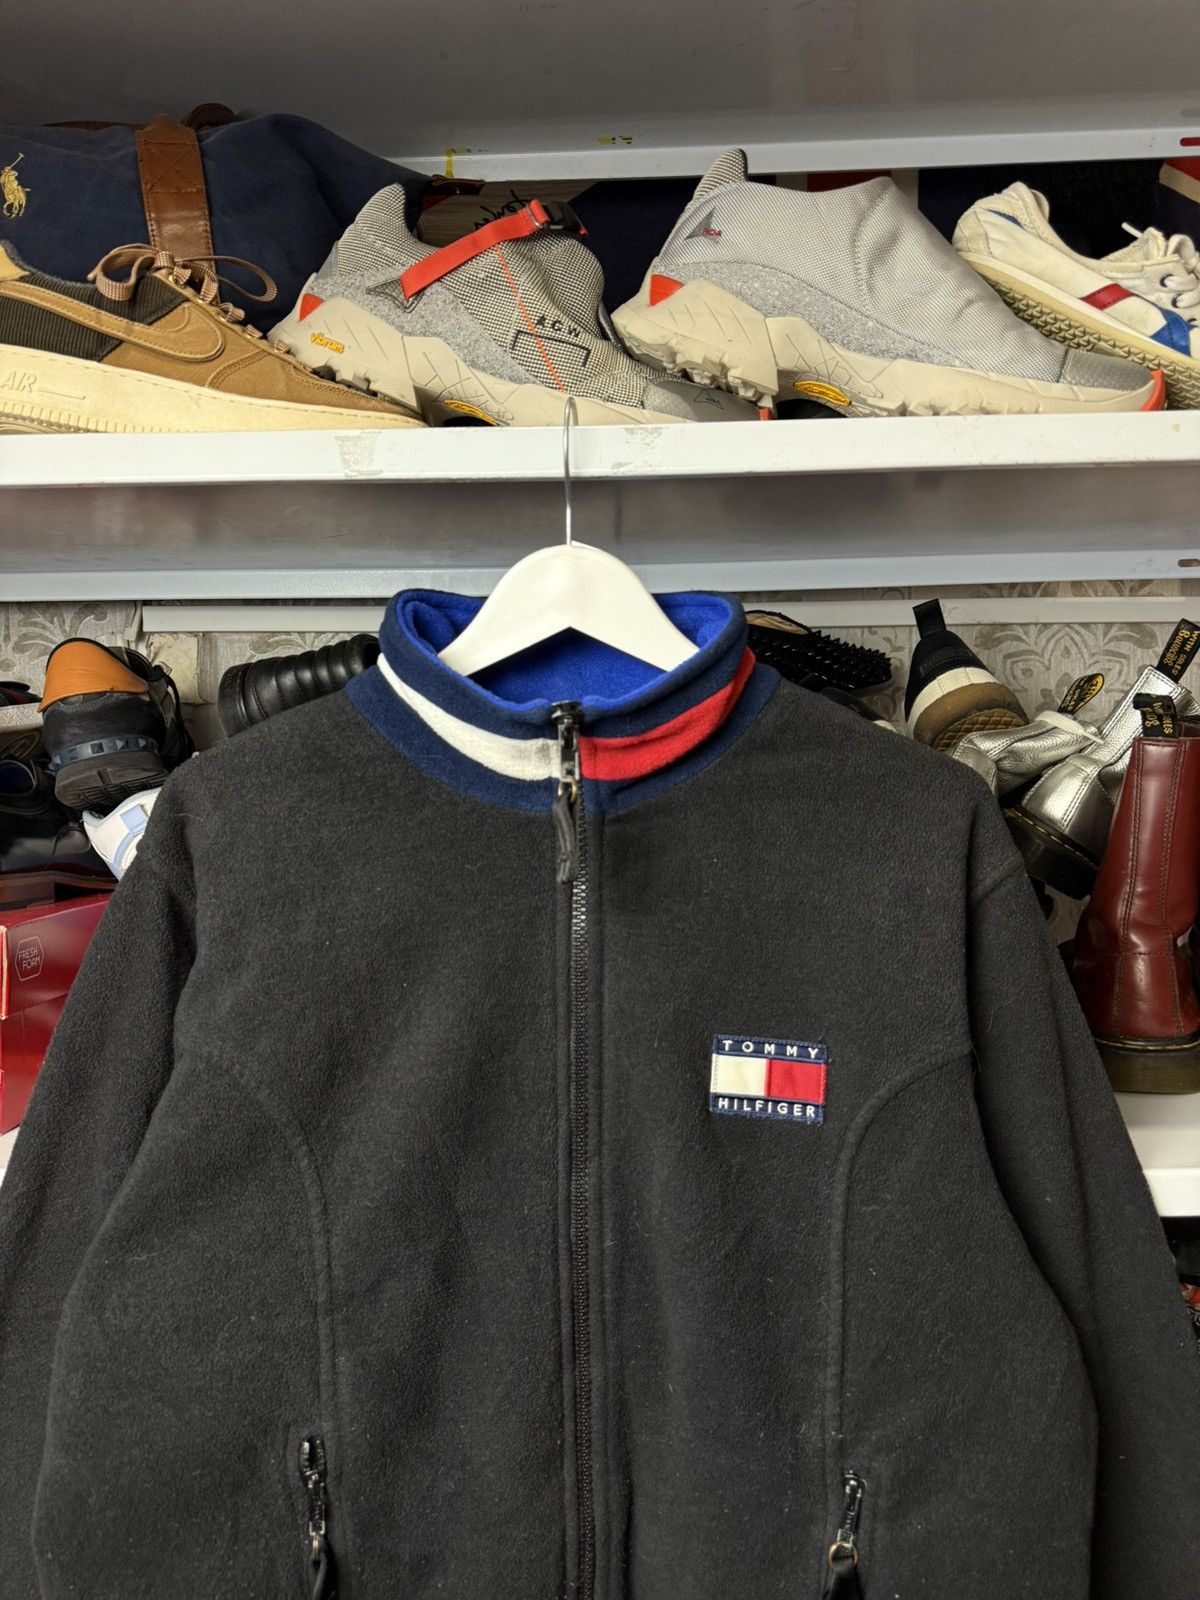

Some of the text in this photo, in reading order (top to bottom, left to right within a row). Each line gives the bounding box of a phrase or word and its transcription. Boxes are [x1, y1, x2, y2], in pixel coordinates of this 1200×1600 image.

[0, 371, 37, 393] AIR
[18, 946, 39, 960] FRESH
[22, 955, 41, 970] FOAM
[722, 1040, 819, 1059] TOMMY
[718, 1097, 816, 1118] HILFIGER
